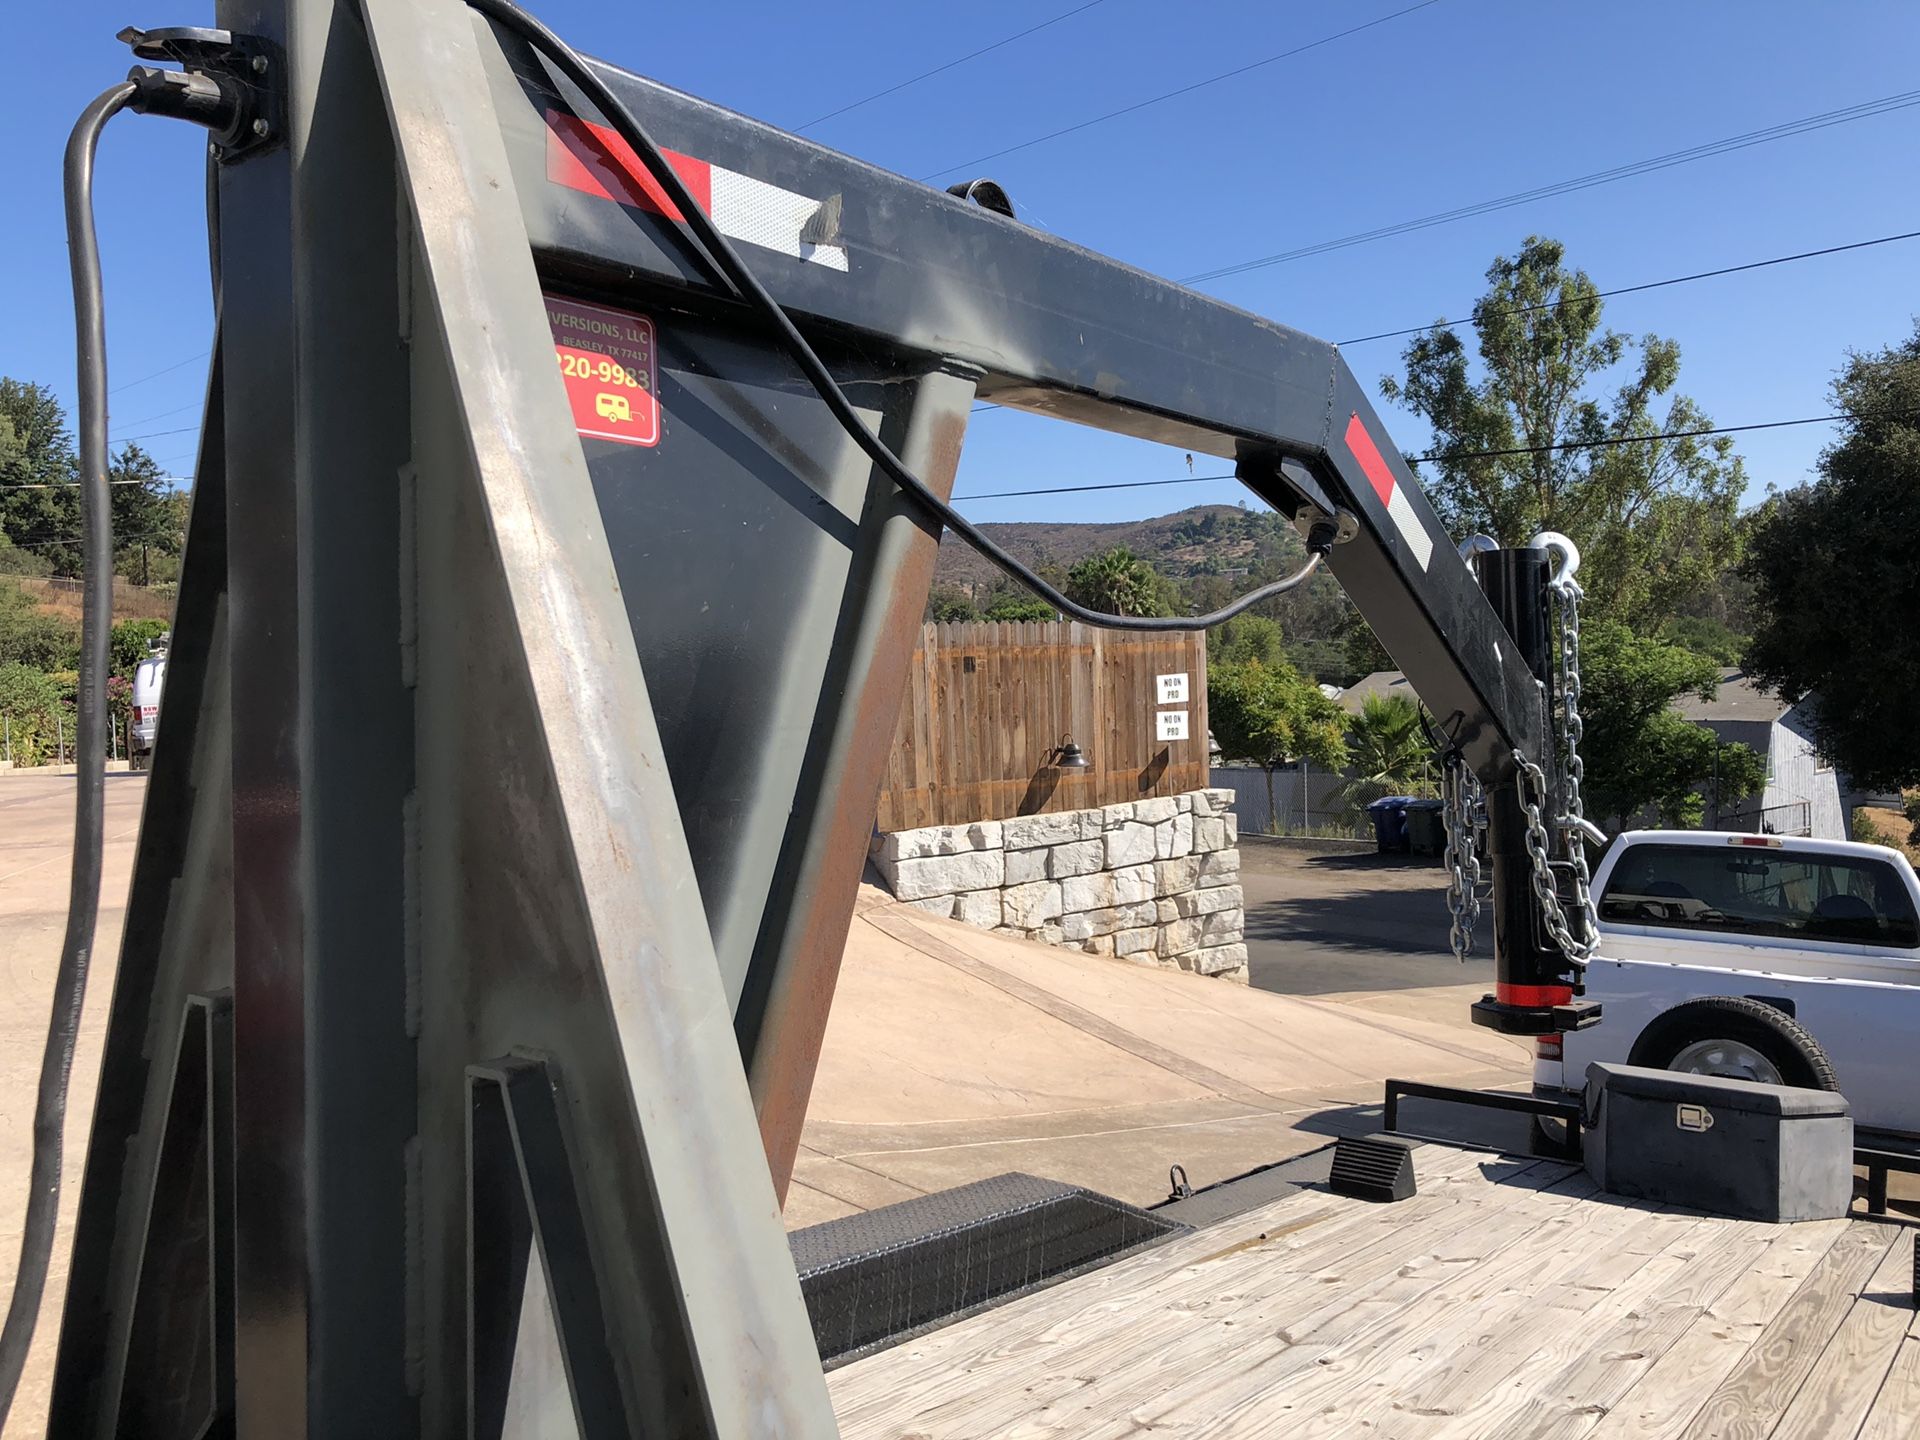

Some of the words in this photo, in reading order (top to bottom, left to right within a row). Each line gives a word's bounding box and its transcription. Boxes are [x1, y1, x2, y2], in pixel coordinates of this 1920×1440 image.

[547, 311, 624, 342] VERSIONS,
[627, 328, 649, 344] LLC
[563, 336, 606, 353] BEASLEY,
[608, 346, 620, 356] TX
[621, 350, 648, 362] 77417
[77, 948, 87, 967] USA
